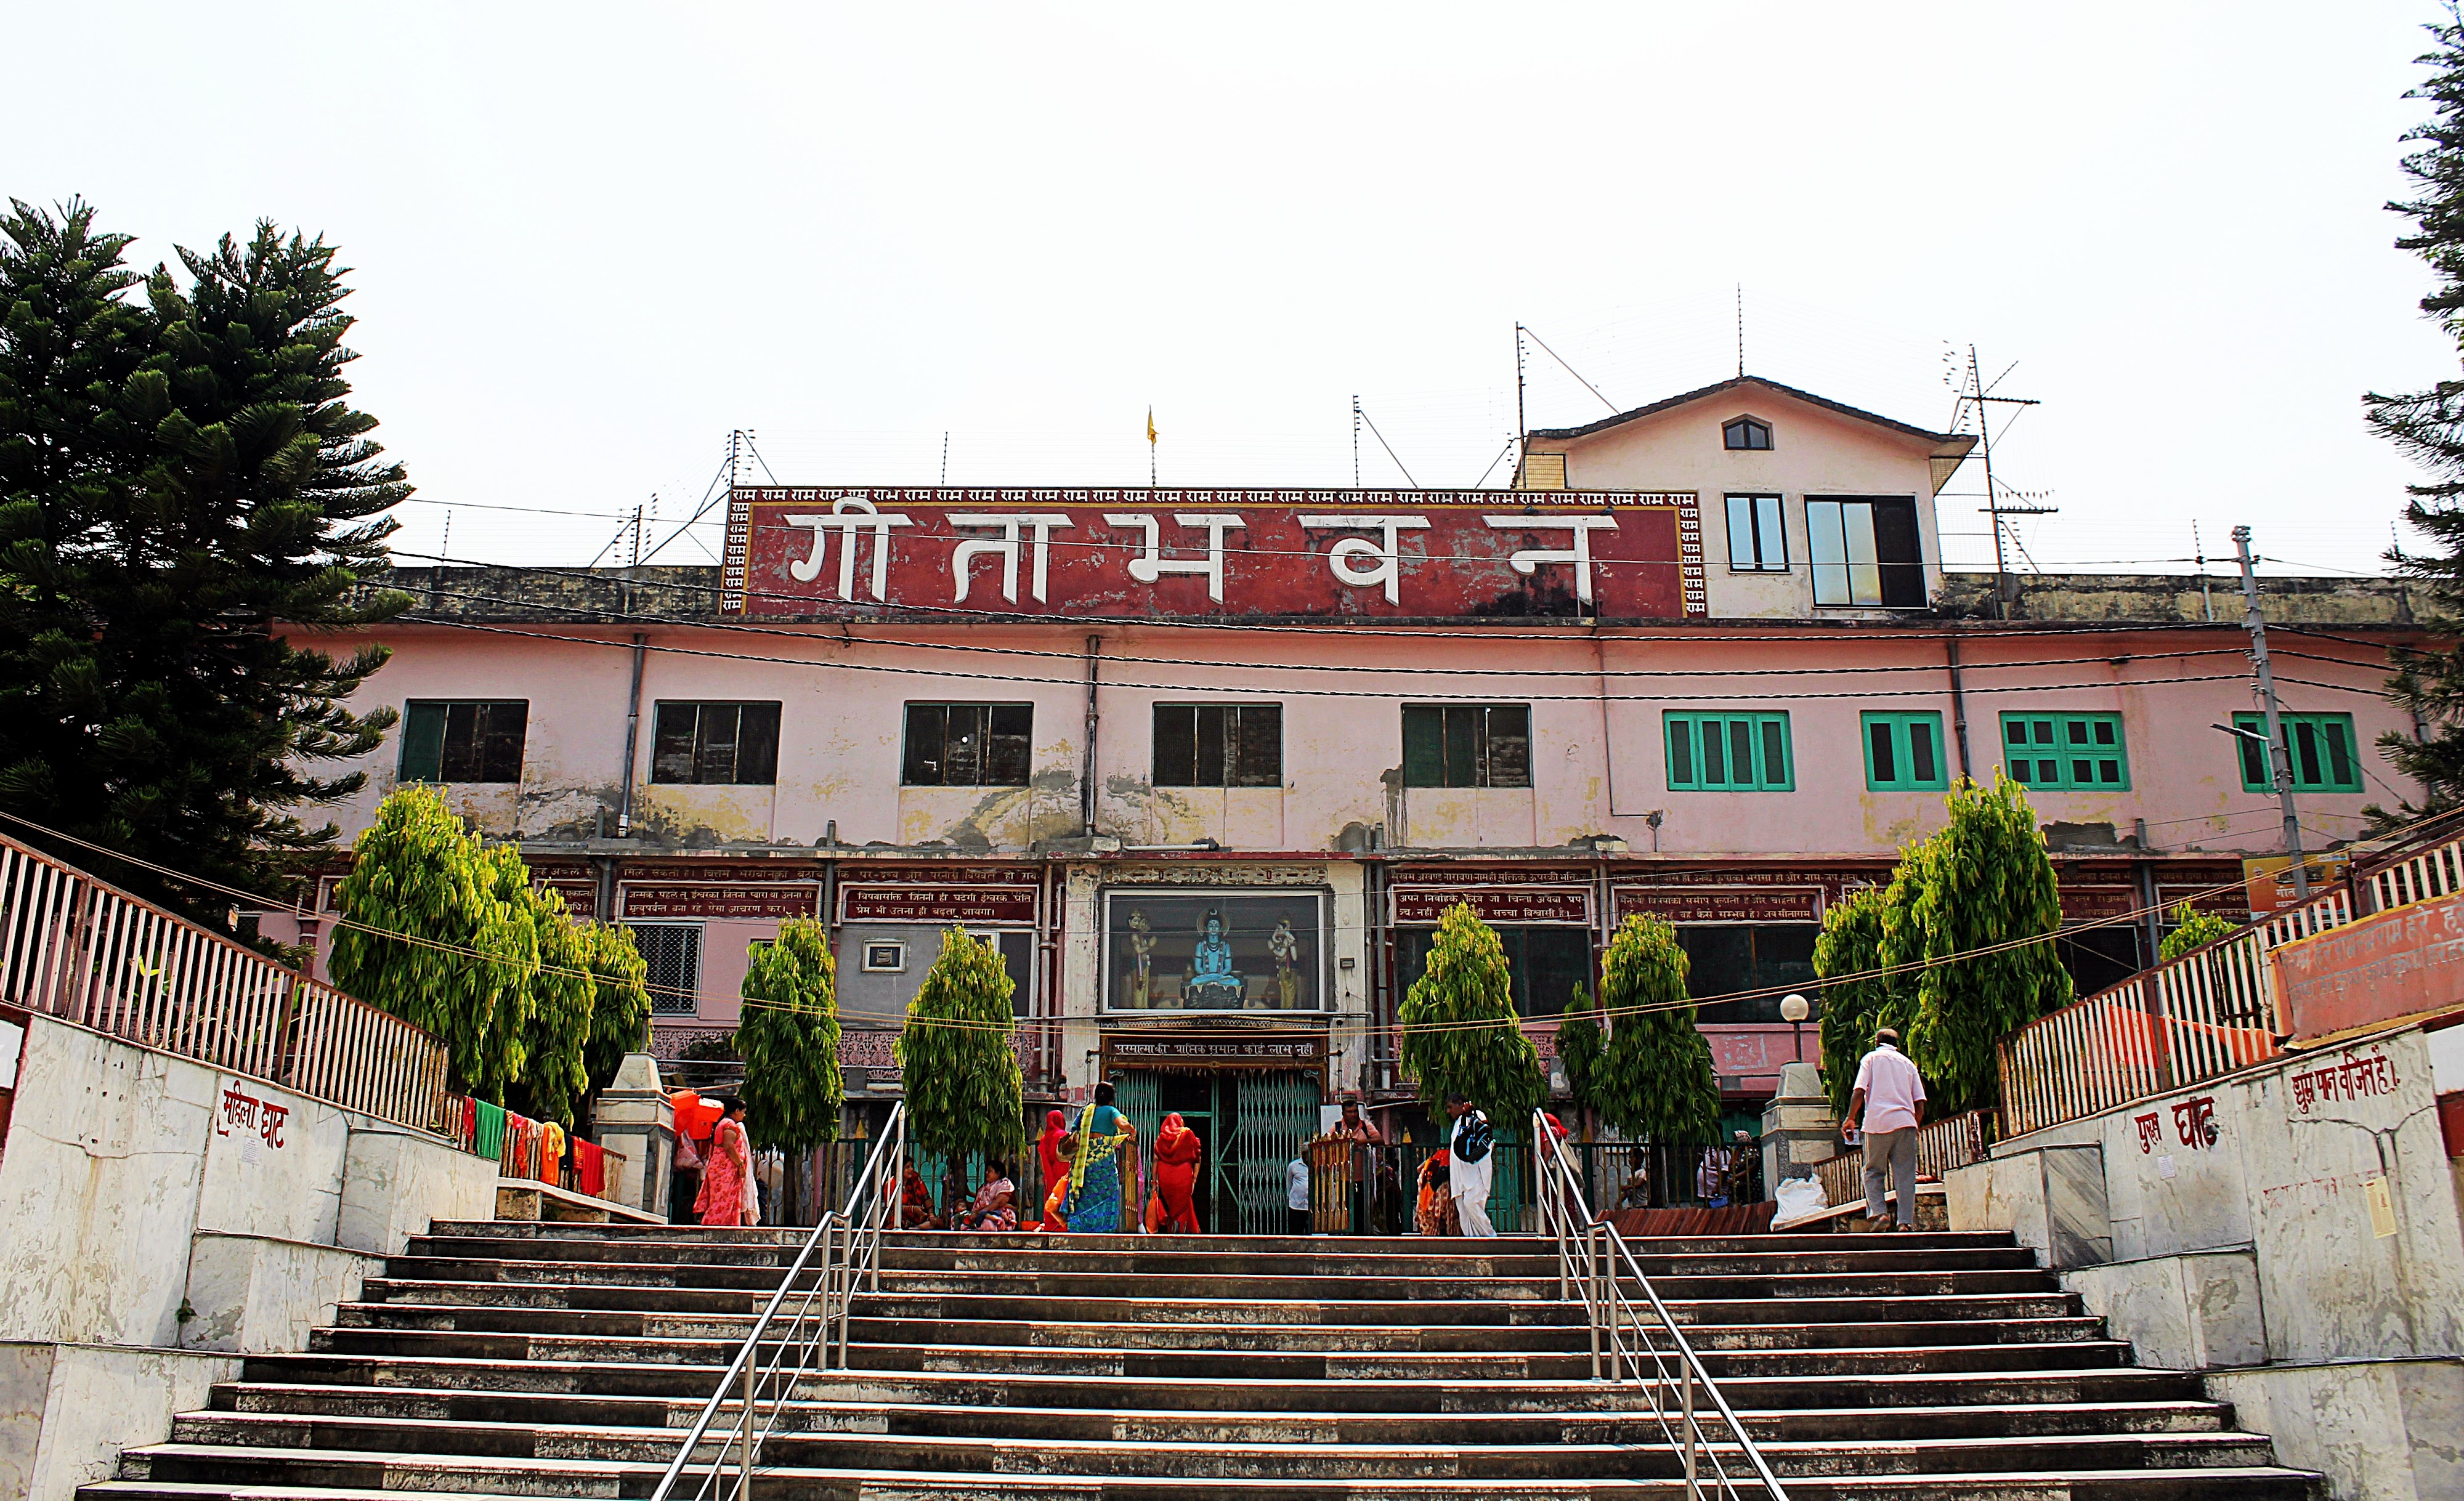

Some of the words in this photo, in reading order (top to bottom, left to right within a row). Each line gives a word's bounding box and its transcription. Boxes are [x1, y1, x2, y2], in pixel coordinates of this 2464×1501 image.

[734, 489, 757, 501] राम
[762, 489, 787, 501] राम
[792, 489, 817, 501] राम
[819, 489, 844, 501] राम
[847, 489, 869, 498] राम
[873, 489, 901, 501] राम
[904, 489, 932, 501] राम
[937, 489, 965, 501] राम
[968, 490, 997, 502] राम
[1001, 490, 1028, 502] राम
[1032, 490, 1061, 502] राम
[1063, 490, 1088, 502] राम
[1092, 490, 1119, 502] राम
[1123, 490, 1149, 502] राम
[1153, 490, 1182, 502] राम
[1186, 490, 1214, 502] राम
[1217, 491, 1243, 503] राम
[1246, 491, 1273, 503] राम
[1278, 491, 1305, 503] राम
[1308, 491, 1336, 503] राम
[1339, 491, 1366, 503] राम
[1368, 491, 1393, 503] राम
[1398, 491, 1425, 503] राम
[1428, 492, 1453, 504] राम
[1457, 493, 1485, 504] राम
[1489, 493, 1515, 504] राम
[1518, 493, 1546, 504] राम
[1550, 493, 1576, 504] राम
[1579, 493, 1605, 504] राम
[1609, 493, 1637, 504] राम
[1639, 493, 1666, 504] राम
[1668, 493, 1695, 504] राम
[732, 503, 750, 512] राम
[731, 513, 749, 522] राम
[1679, 508, 1698, 518] राम
[1680, 520, 1699, 530] राम
[729, 534, 747, 544] राम
[1681, 532, 1700, 542] राम
[727, 545, 746, 555] राम
[784, 496, 1076, 607] गीता
[1103, 513, 1619, 607] भवन
[1682, 543, 1701, 553] राम
[727, 556, 745, 566] राम
[1683, 555, 1701, 565] राम
[726, 567, 744, 577] राम
[1684, 567, 1702, 576] राम
[725, 578, 744, 588] राम
[1684, 578, 1703, 588] राम
[1685, 590, 1704, 600] राम
[723, 600, 742, 610] राम
[1686, 602, 1705, 613] राम
[835, 868, 849, 879] कि
[1003, 870, 1015, 880] हो
[629, 889, 654, 899] जन्मके
[658, 889, 678, 899] पहले
[691, 889, 719, 899] ईश्वरका
[723, 889, 746, 899] जितना
[749, 891, 768, 899] प्यारा
[770, 891, 778, 899] था
[939, 892, 949, 902] ही
[953, 892, 976, 902] घटेगी
[981, 892, 1007, 903] ईश्वरके
[1400, 893, 1419, 902] अपने
[1489, 893, 1500, 903] जो
[1508, 894, 1532, 903] चिन्ता
[691, 902, 702, 913] रहे
[708, 902, 725, 914] ऐसा
[728, 904, 761, 913] आचरण
[856, 904, 871, 915] प्रेम
[876, 904, 886, 915] भी
[889, 907, 914, 915] उतना
[918, 905, 927, 916] ही
[1417, 907, 1433, 916] नहीं
[1493, 909, 1517, 917] सच्चा
[1524, 908, 1555, 917] विश्वासी
[1696, 908, 1713, 919] कैसे
[1778, 908, 1811, 918] सीताराम
[1114, 1042, 1170, 1054] परमात्माकी
[1175, 1042, 1207, 1054] प्राप्तिके
[1208, 1044, 1239, 1054] समान
[1242, 1042, 1265, 1054] कोई
[1268, 1044, 1293, 1054] लाभ
[2314, 1067, 2340, 1102] पान
[261, 1101, 290, 1149] घाट
[2171, 1096, 2218, 1150] घाट
